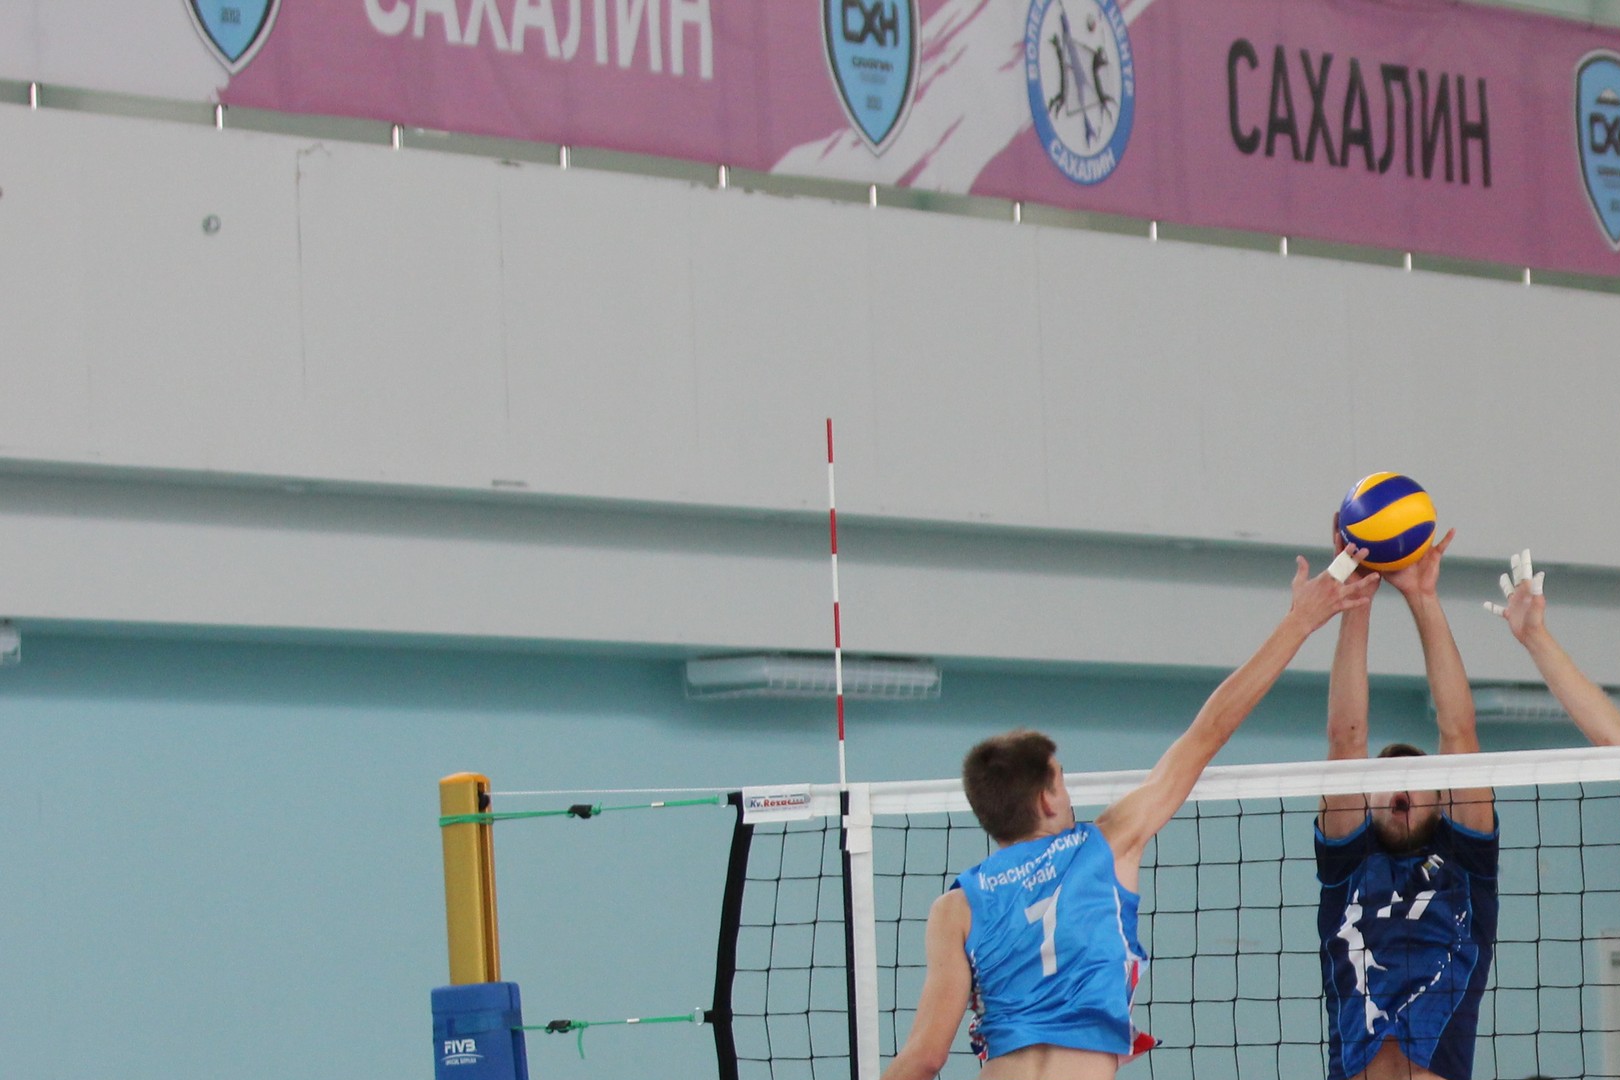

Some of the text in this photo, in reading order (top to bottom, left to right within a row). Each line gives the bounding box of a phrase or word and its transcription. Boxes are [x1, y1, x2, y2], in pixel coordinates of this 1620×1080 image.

[1227, 38, 1491, 187] САХАЛИН
[1024, 885, 1063, 977] 7
[444, 1038, 477, 1055] FIVB
